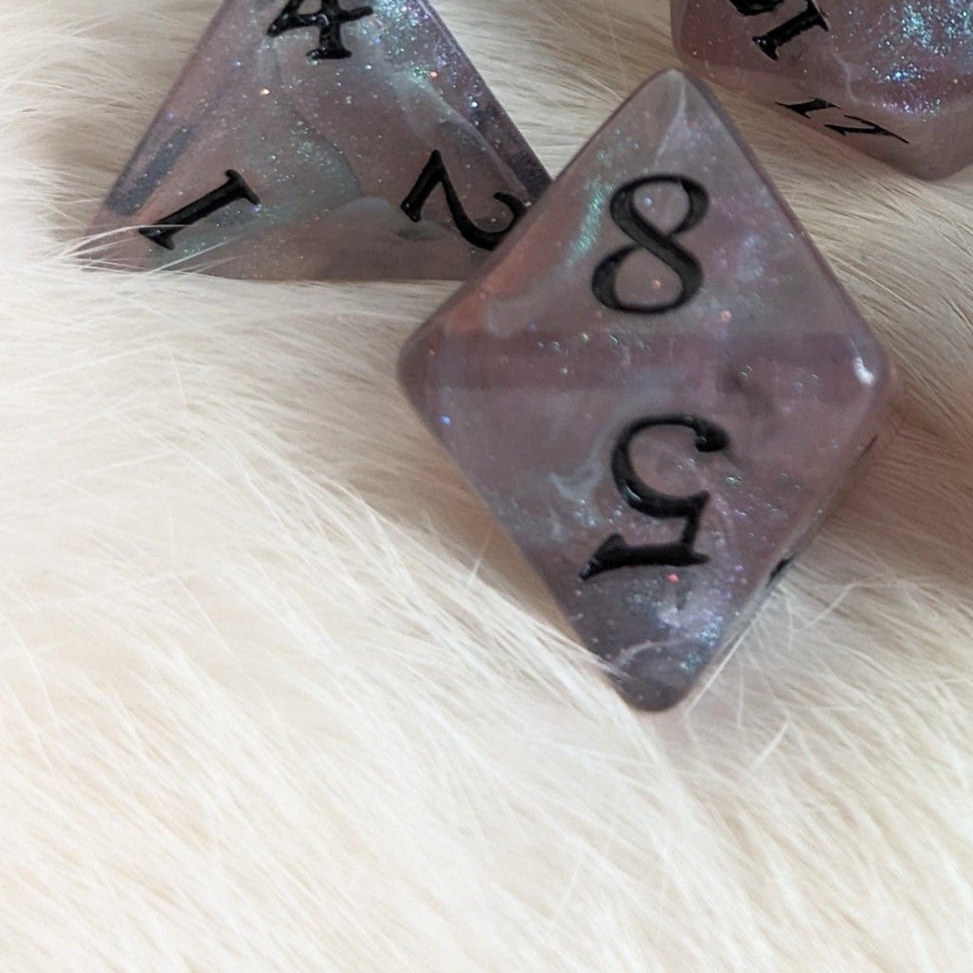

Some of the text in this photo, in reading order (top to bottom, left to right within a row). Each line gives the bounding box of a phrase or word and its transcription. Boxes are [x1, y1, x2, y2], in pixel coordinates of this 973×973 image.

[138, 168, 262, 251] 1
[400, 148, 530, 252] 2
[591, 174, 711, 316] 8
[577, 413, 731, 581] 5
